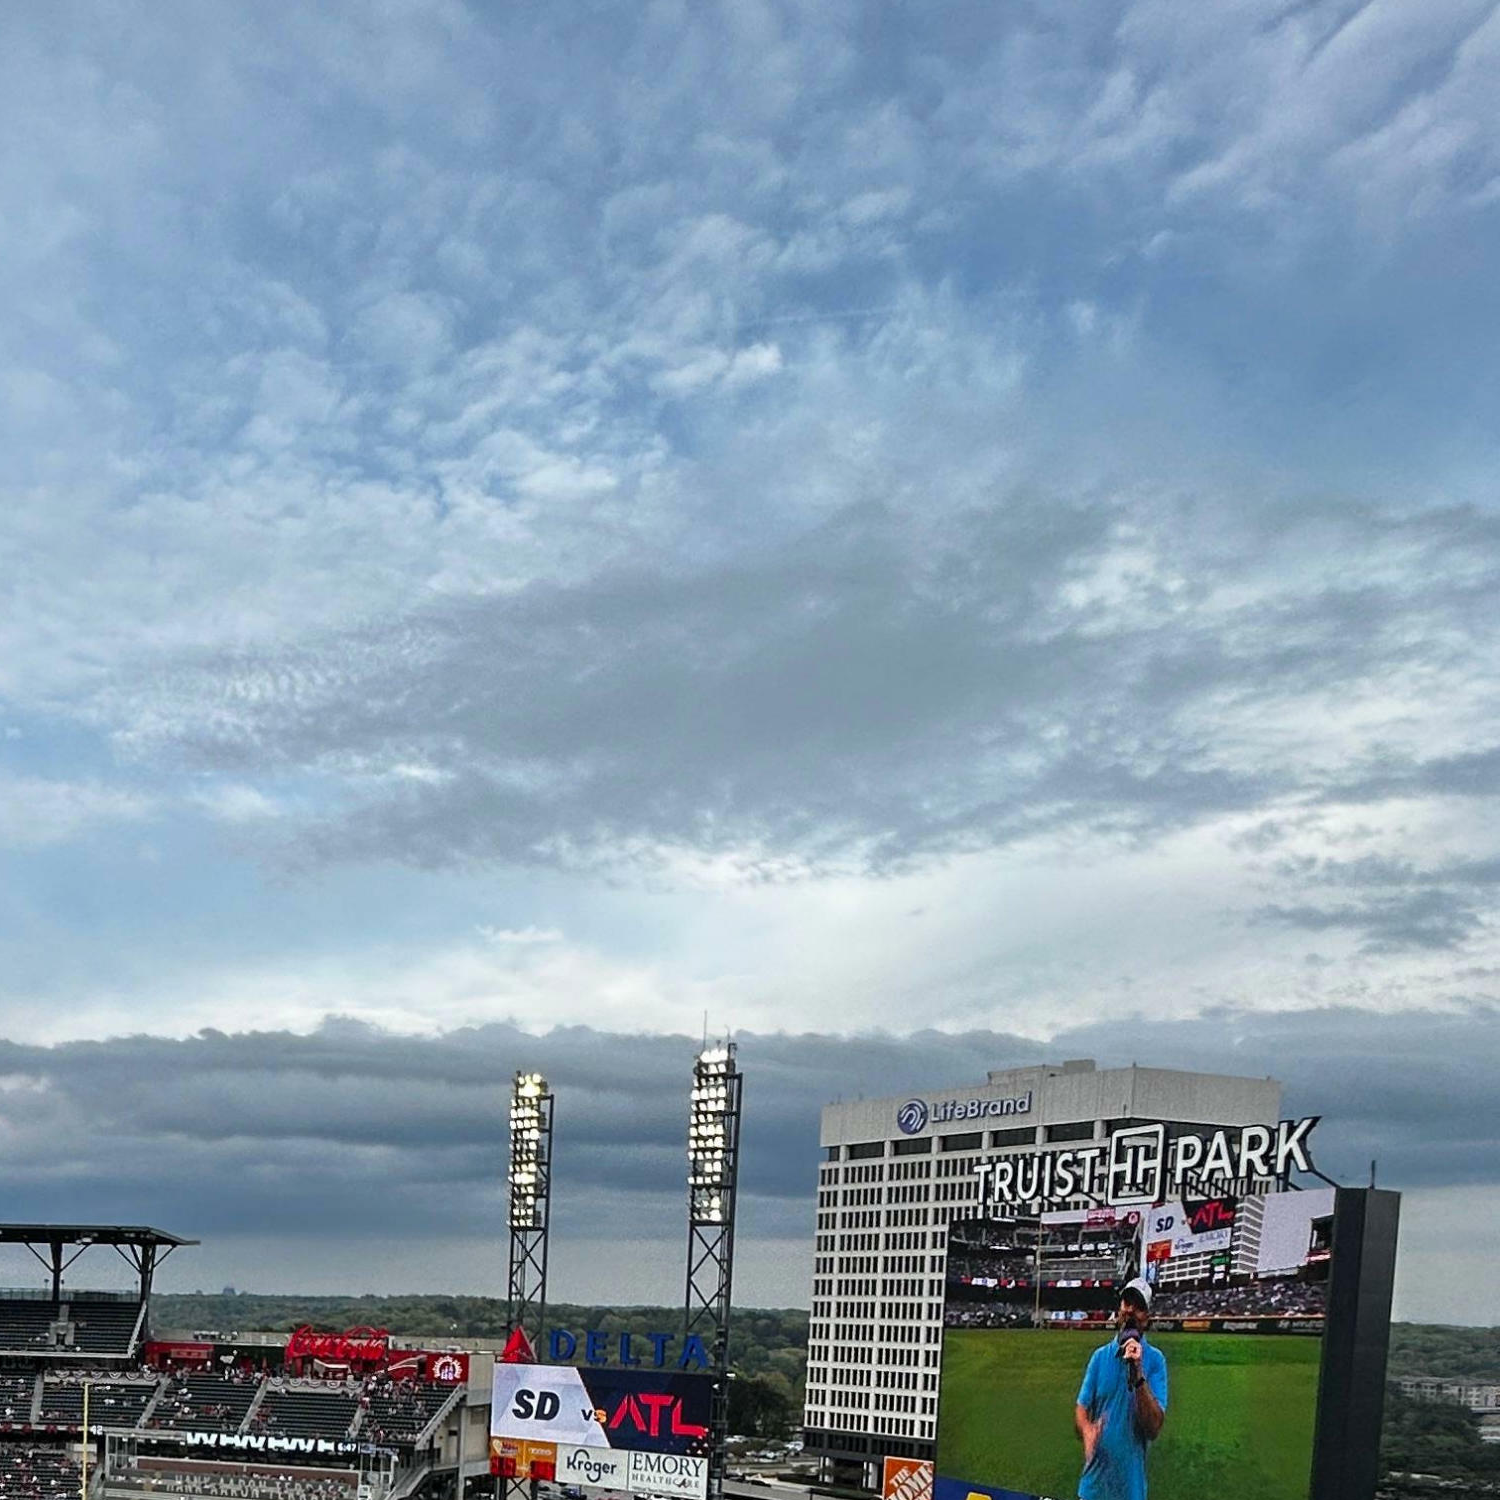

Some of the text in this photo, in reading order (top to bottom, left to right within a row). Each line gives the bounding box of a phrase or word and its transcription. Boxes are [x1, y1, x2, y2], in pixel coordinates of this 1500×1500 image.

[930, 1091, 1032, 1122] LifeBrand
[973, 1117, 1320, 1203] TRUIST PARK
[550, 1329, 709, 1368] DELTA
[512, 1389, 560, 1421] SD
[609, 1394, 708, 1437] ATL
[566, 1449, 617, 1483] Kroger
[632, 1453, 704, 1478] EMORY
[889, 1465, 912, 1488] THE
[632, 1475, 700, 1489] HEALTHCARE
